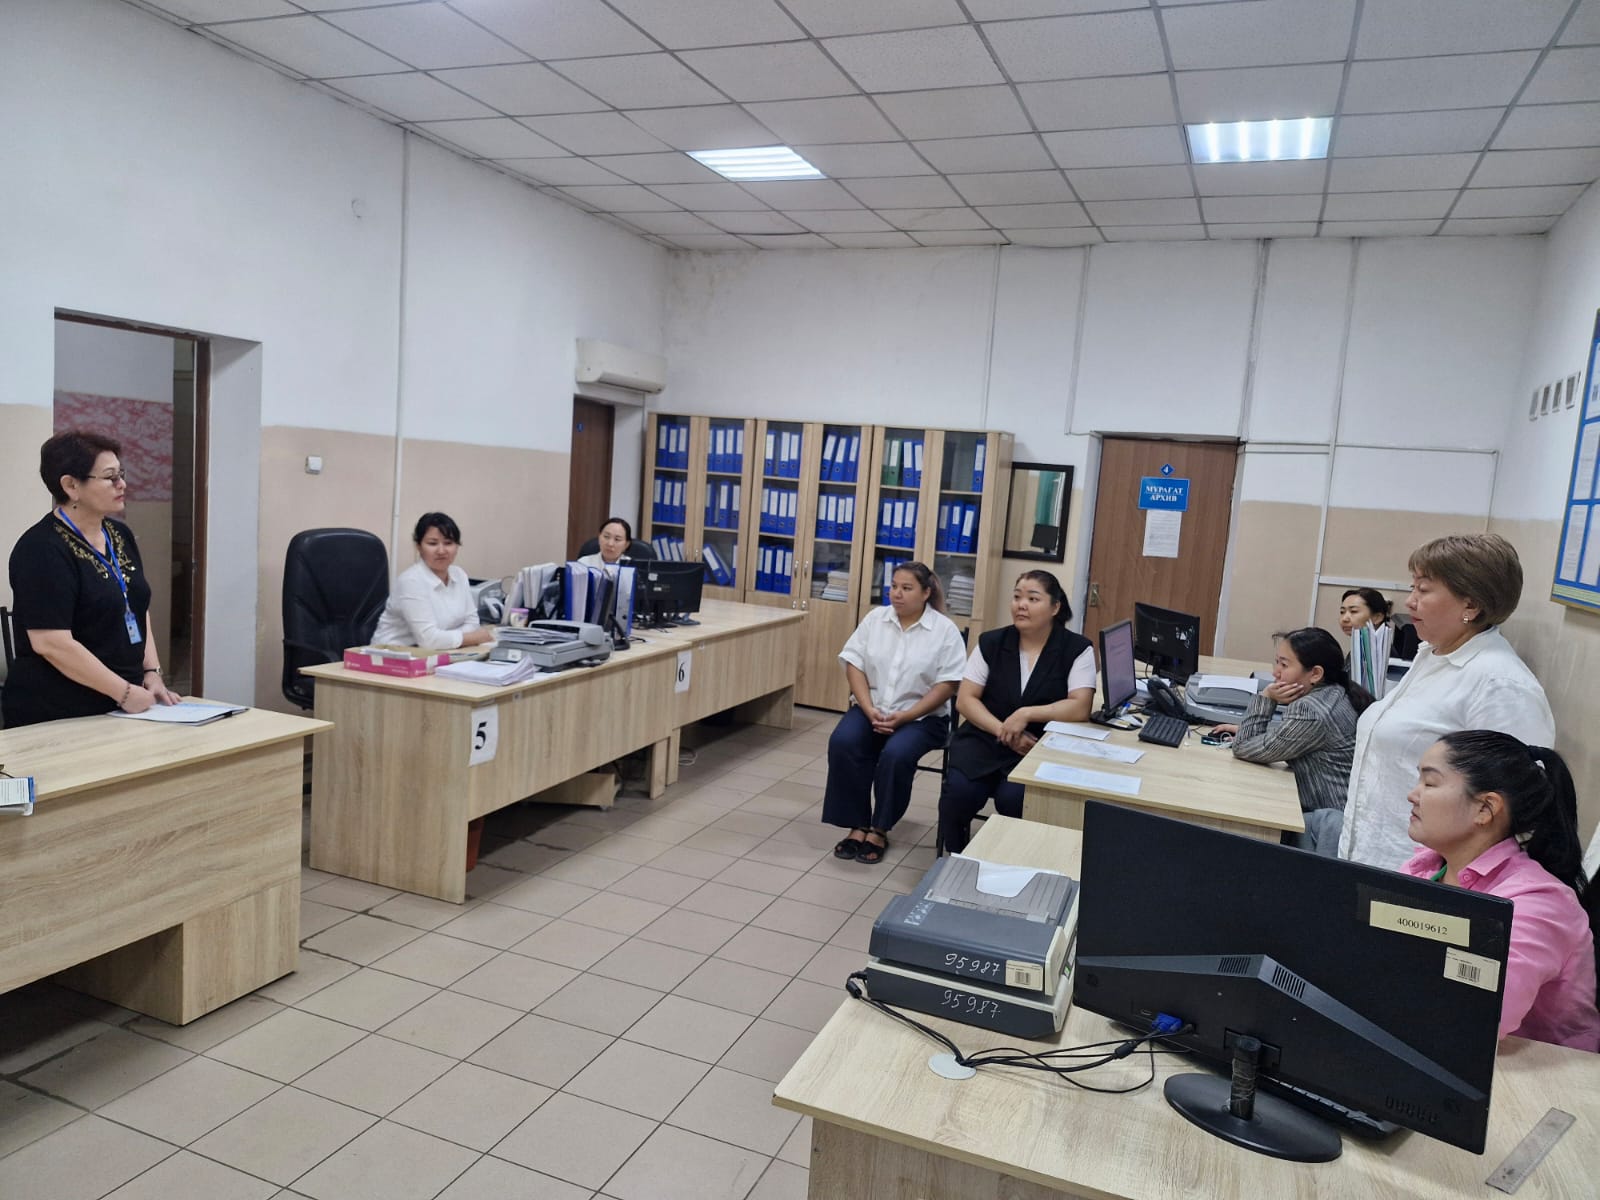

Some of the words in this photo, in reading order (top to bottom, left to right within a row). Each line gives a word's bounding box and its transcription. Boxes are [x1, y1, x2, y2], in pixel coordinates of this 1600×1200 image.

[1150, 494, 1177, 502] АРХИВ
[678, 662, 685, 682] 6
[474, 721, 487, 750] 5
[1396, 917, 1448, 935] 400019612
[944, 953, 1000, 976] 95987
[940, 989, 1001, 1019] 95987
